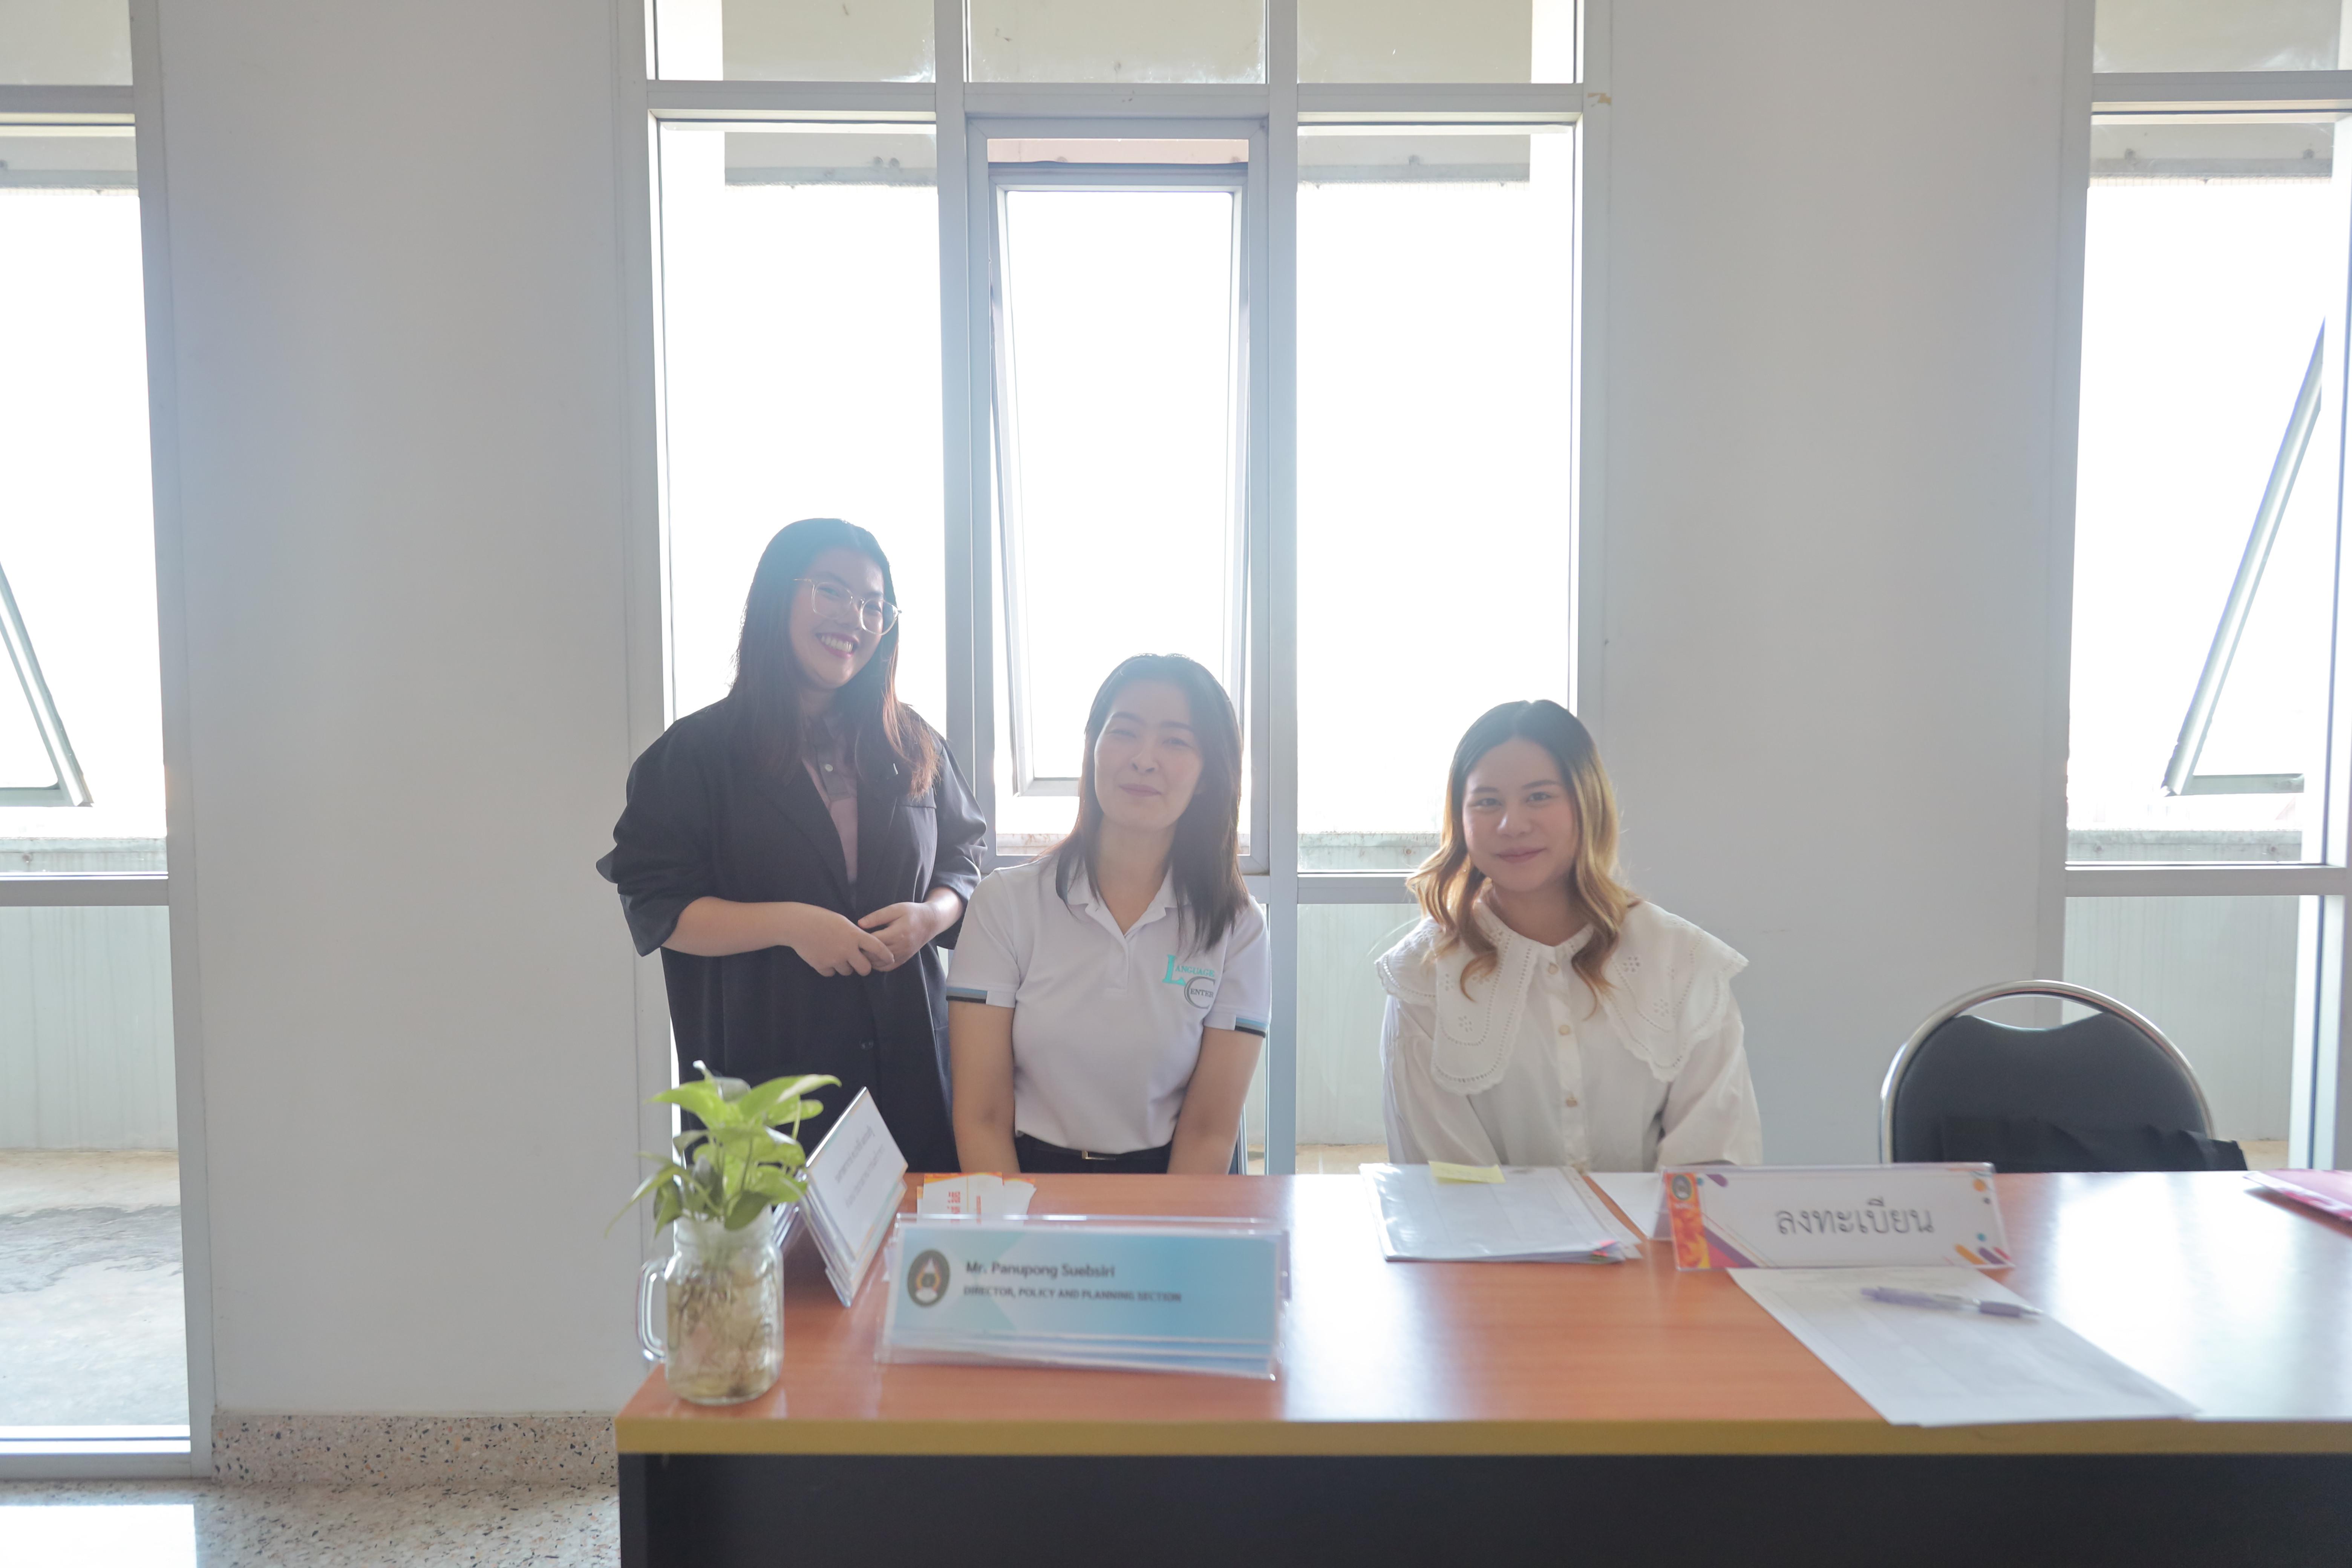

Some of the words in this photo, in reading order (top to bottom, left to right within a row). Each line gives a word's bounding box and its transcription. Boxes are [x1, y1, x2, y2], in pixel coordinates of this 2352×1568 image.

[1162, 954, 1215, 986] LANGUAGE
[1775, 1197, 1934, 1234] ลงทะเบียน
[966, 1261, 987, 1273] Mr.
[991, 1261, 1058, 1279] Panupong
[1061, 1263, 1115, 1277] Suebsiri
[964, 1286, 1016, 1298] DIRECTOR,
[1019, 1287, 1055, 1297] POLICY
[1058, 1288, 1080, 1298] AND
[1082, 1289, 1135, 1300] PLANNING
[1137, 1291, 1181, 1302] SECTION
